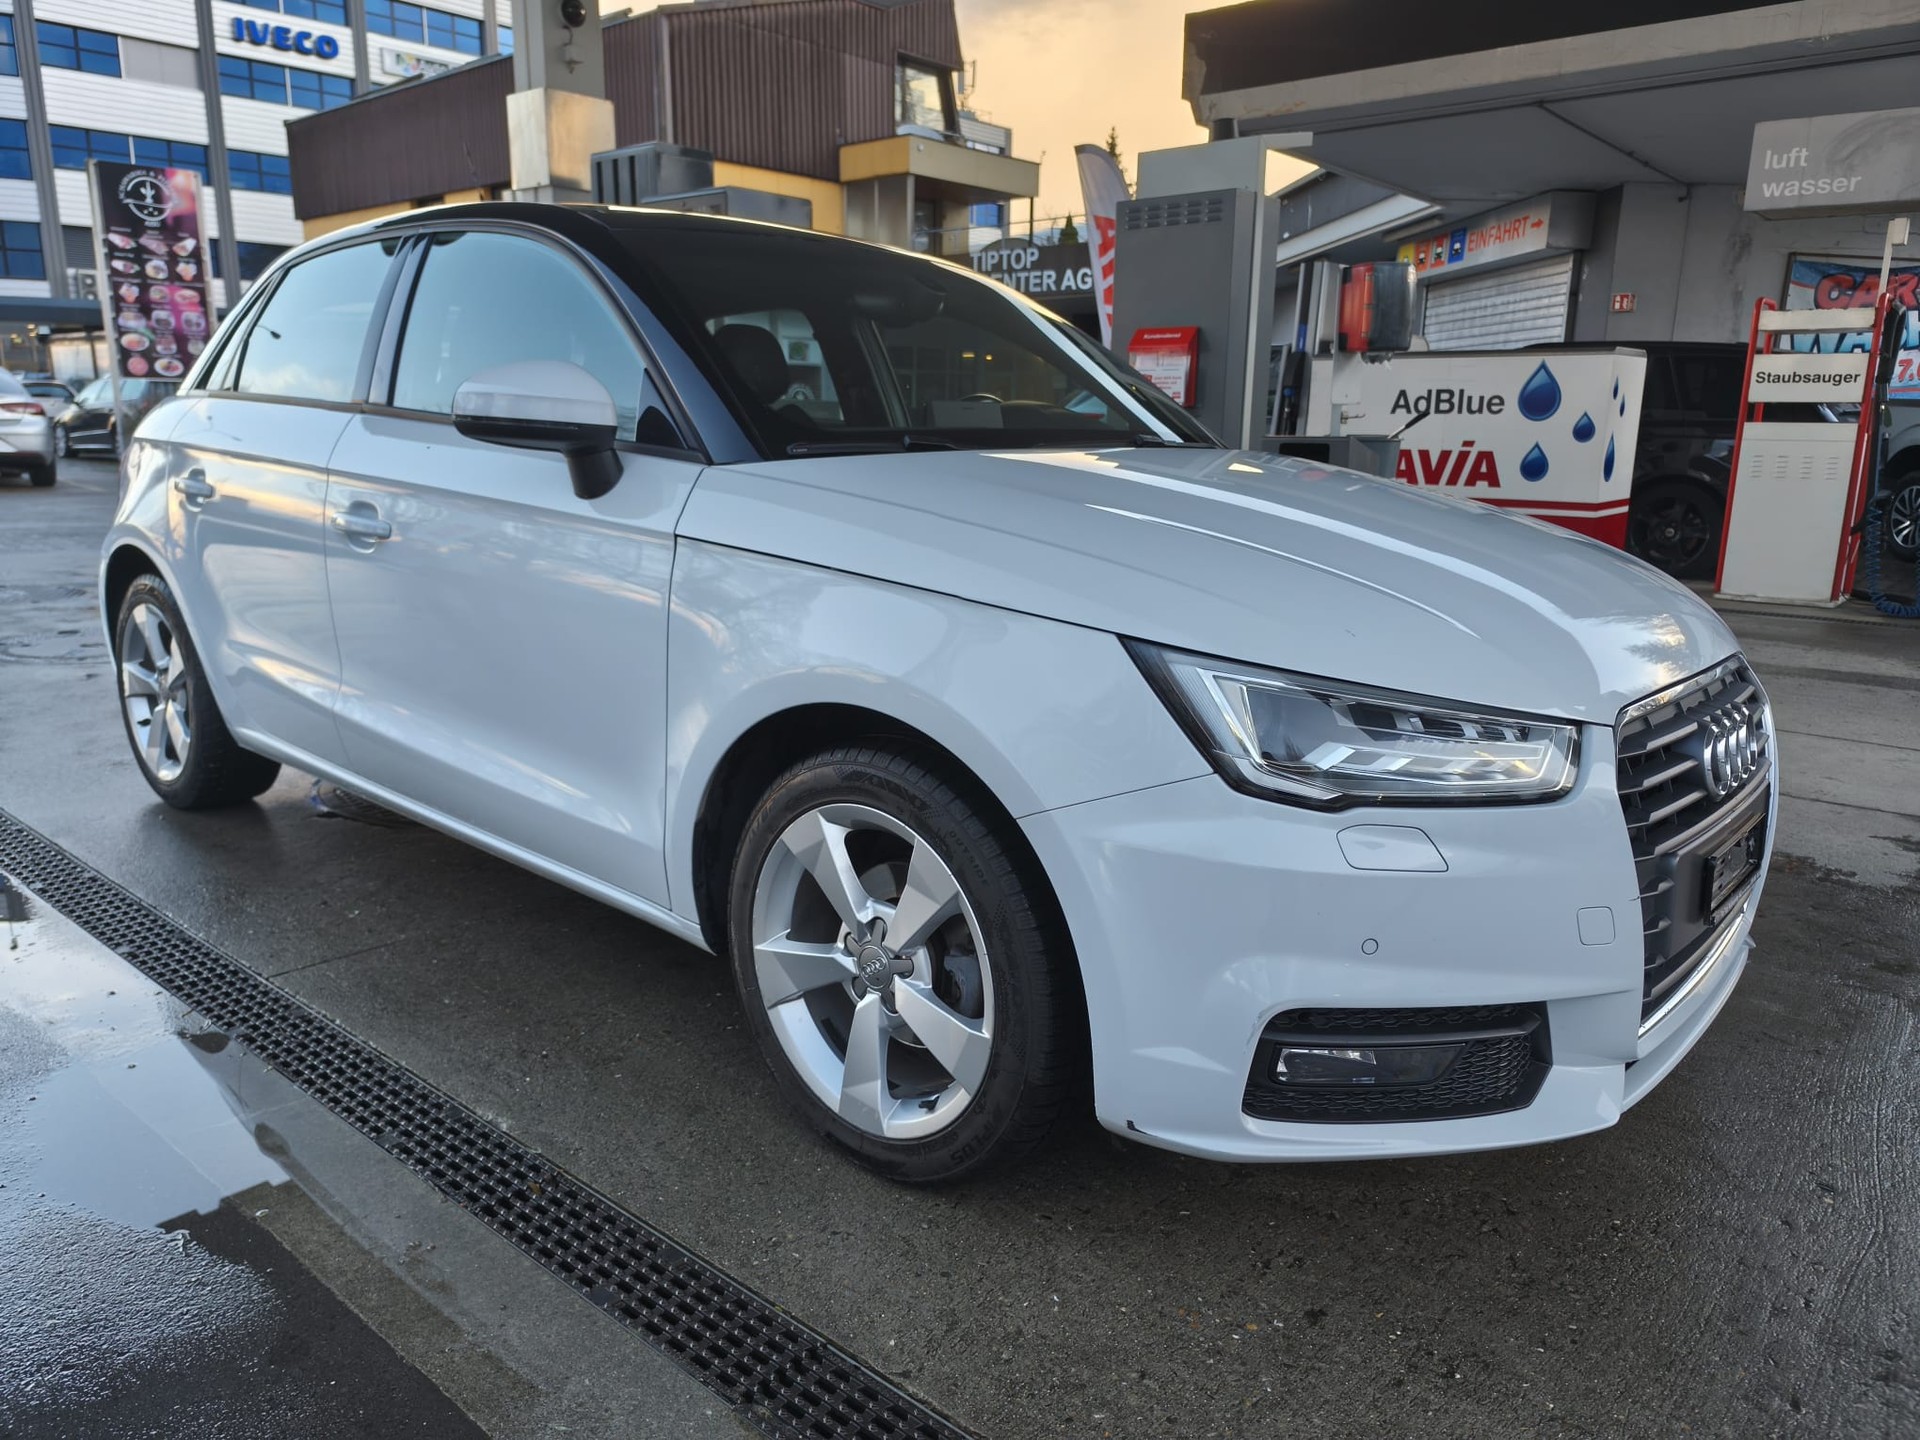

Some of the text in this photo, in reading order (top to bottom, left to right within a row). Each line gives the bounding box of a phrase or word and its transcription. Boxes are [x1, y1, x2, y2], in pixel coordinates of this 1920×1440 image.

[231, 17, 340, 60] IVECO
[1764, 147, 1810, 170] luft
[1762, 176, 1862, 198] wasser
[1467, 215, 1530, 253] EINFAHRT
[970, 247, 1039, 272] TIPTOP
[989, 267, 1093, 293] NTER AG
[1755, 371, 1860, 386] Staubsauger
[1389, 388, 1505, 415] AdBlue
[1395, 440, 1502, 489] AVIA
